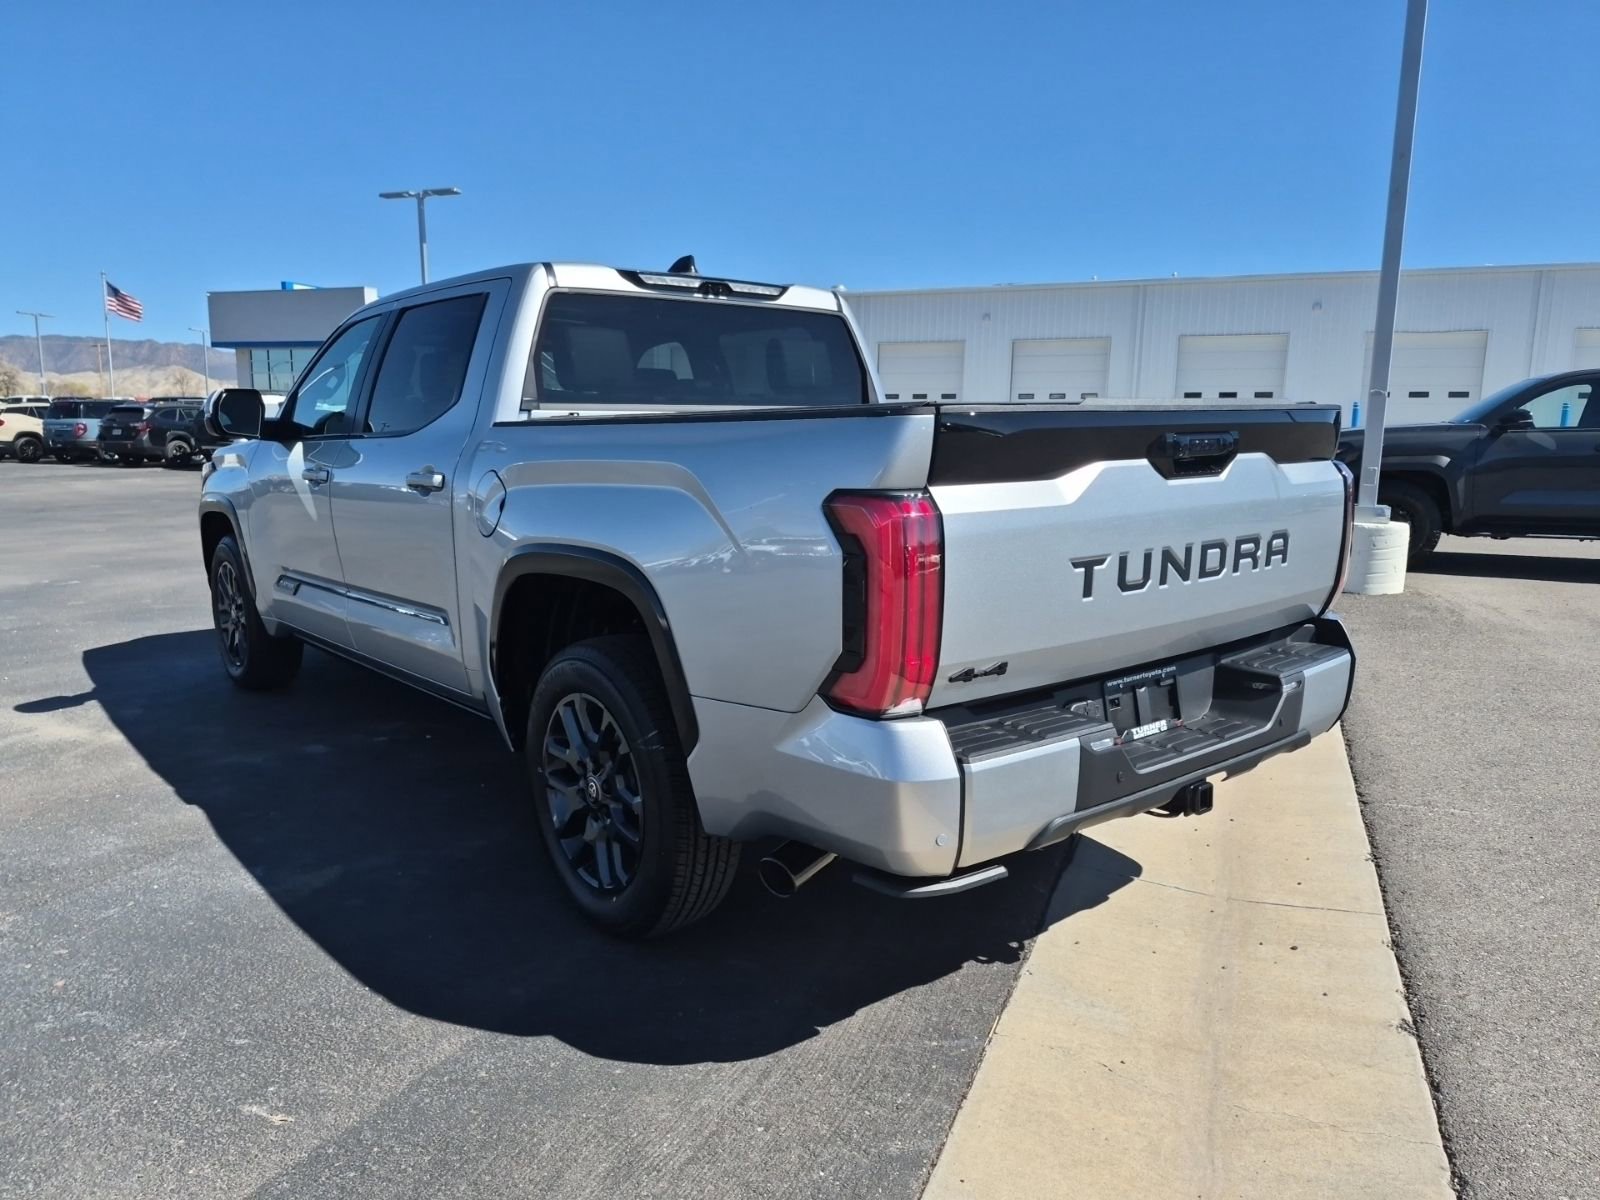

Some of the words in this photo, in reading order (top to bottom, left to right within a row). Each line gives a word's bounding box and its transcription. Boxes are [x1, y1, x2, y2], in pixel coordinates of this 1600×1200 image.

[1069, 528, 1290, 602] TUNDRA
[1106, 665, 1177, 687] www.turnertoyota.com
[1131, 719, 1167, 735] TURNER
